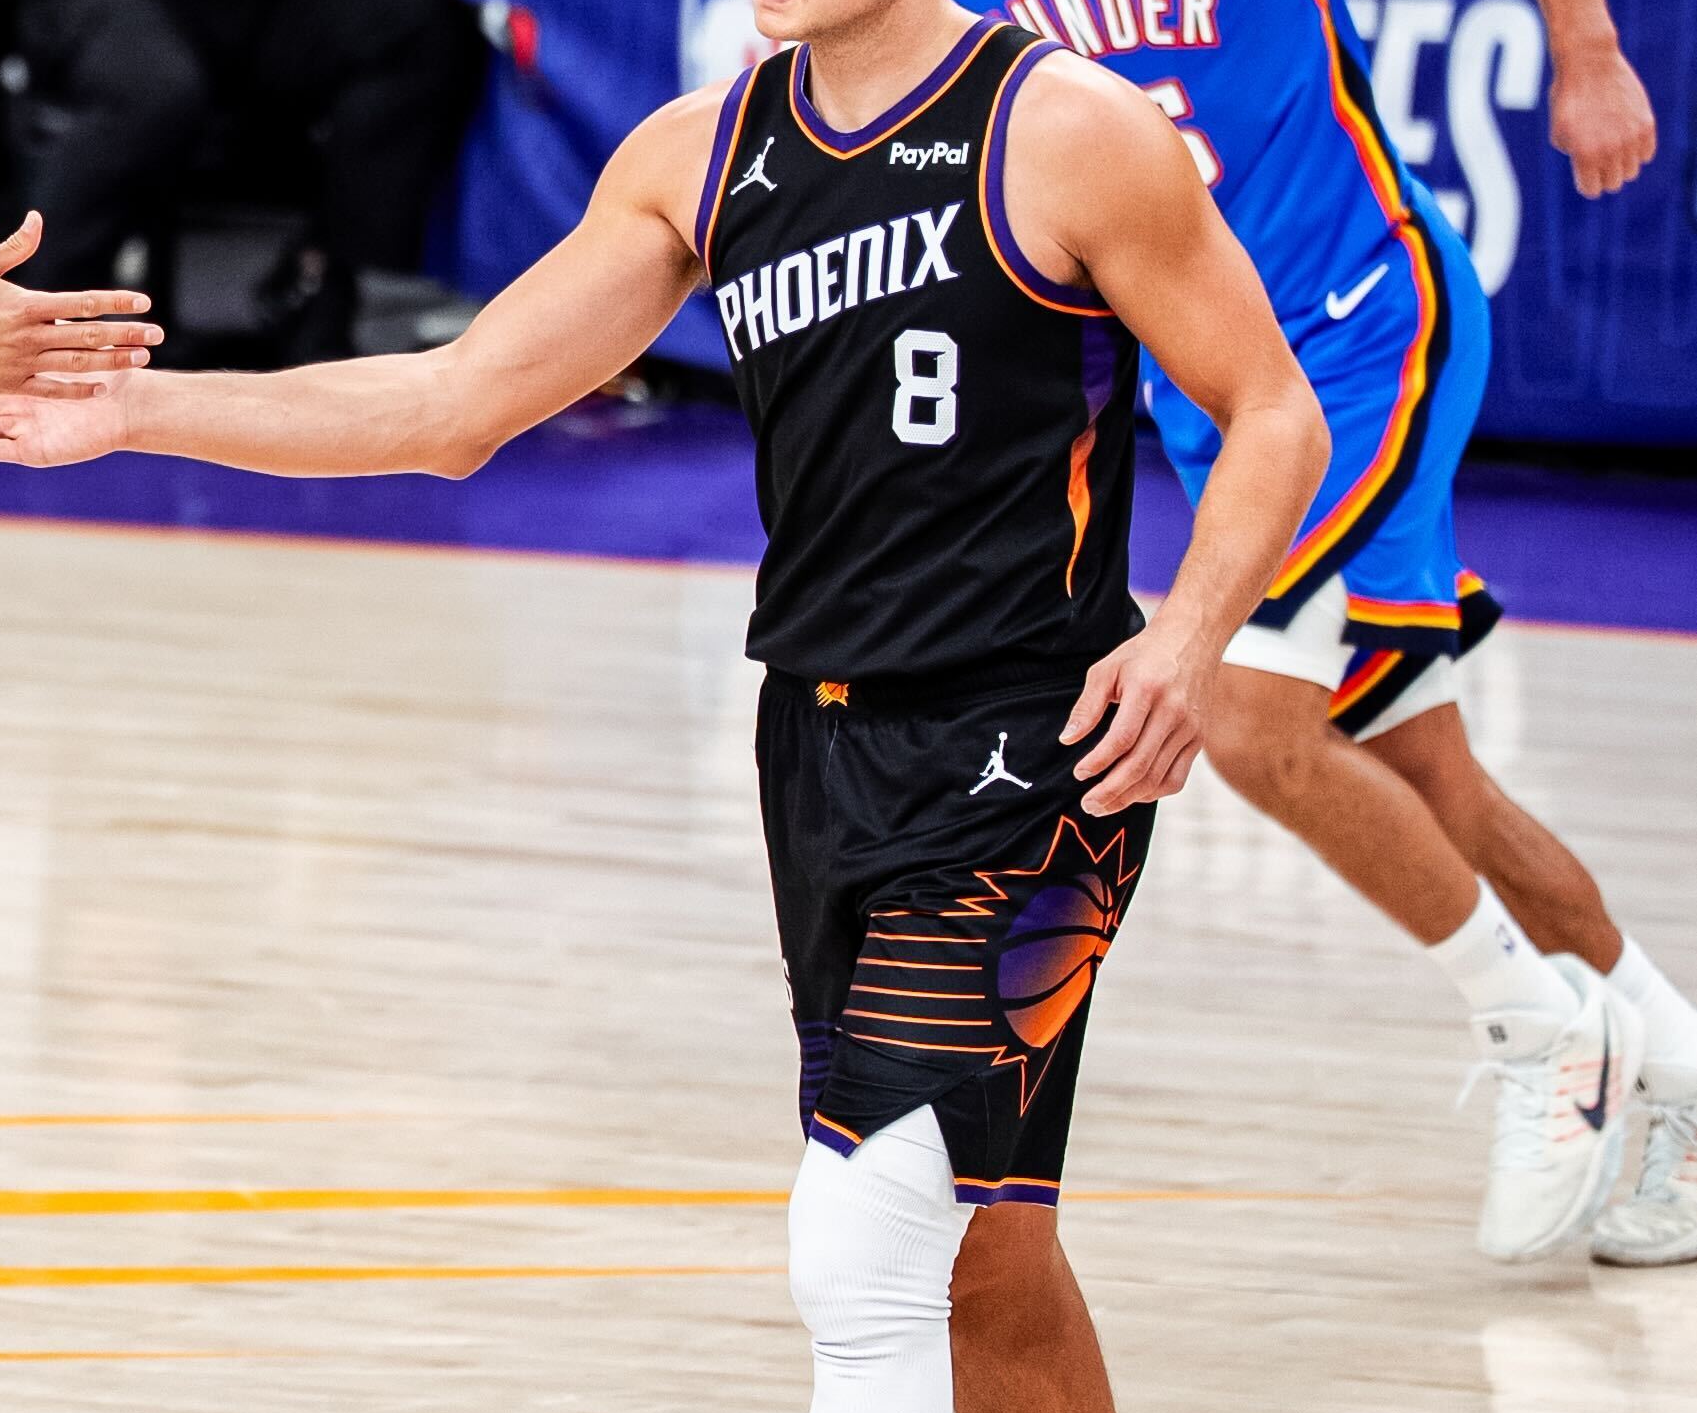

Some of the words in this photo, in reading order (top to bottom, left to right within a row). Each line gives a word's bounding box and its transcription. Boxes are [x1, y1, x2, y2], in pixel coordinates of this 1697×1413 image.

[889, 142, 970, 171] PayPal
[715, 199, 965, 364] PHOENIX
[891, 329, 960, 446] 8
